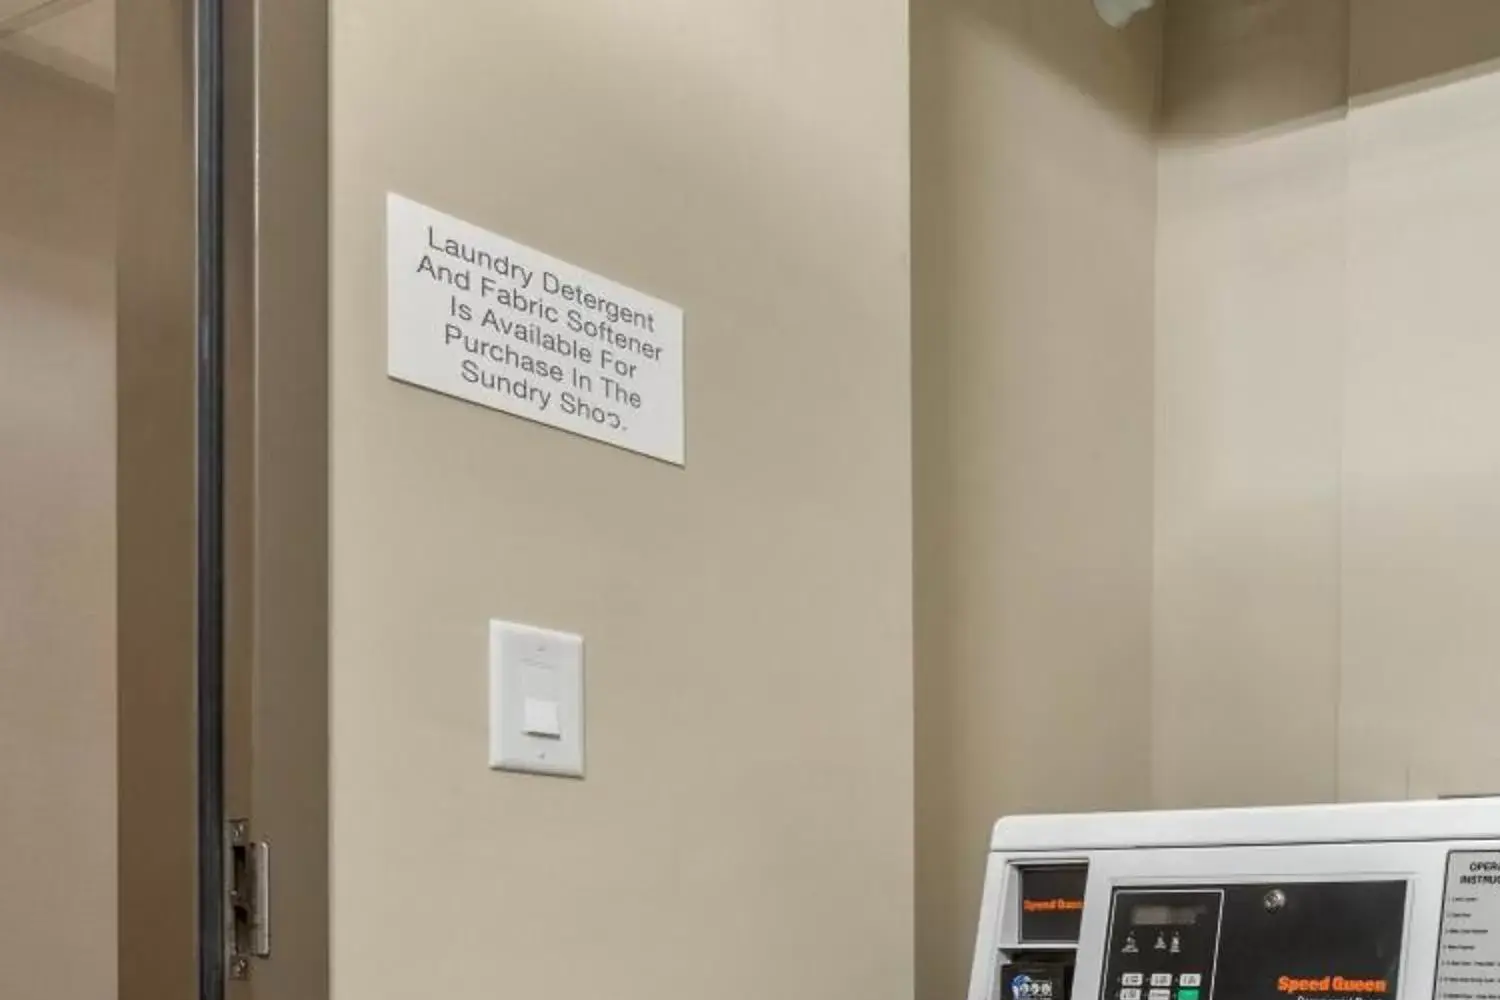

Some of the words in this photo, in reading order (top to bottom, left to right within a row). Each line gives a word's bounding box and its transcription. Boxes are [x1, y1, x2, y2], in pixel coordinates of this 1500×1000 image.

[417, 255, 470, 291] And
[481, 277, 560, 324] Fabric
[566, 309, 664, 361] Softener
[427, 225, 533, 289] Laundry
[543, 271, 655, 333] Detergent
[445, 324, 564, 383] Purchase
[572, 367, 592, 393] In
[600, 376, 642, 409] The
[450, 296, 473, 321] Is
[481, 308, 592, 363] Available
[600, 350, 637, 379] For
[460, 359, 552, 411] Sundry
[1278, 976, 1330, 993] Speed
[1332, 976, 1387, 992] Queen
